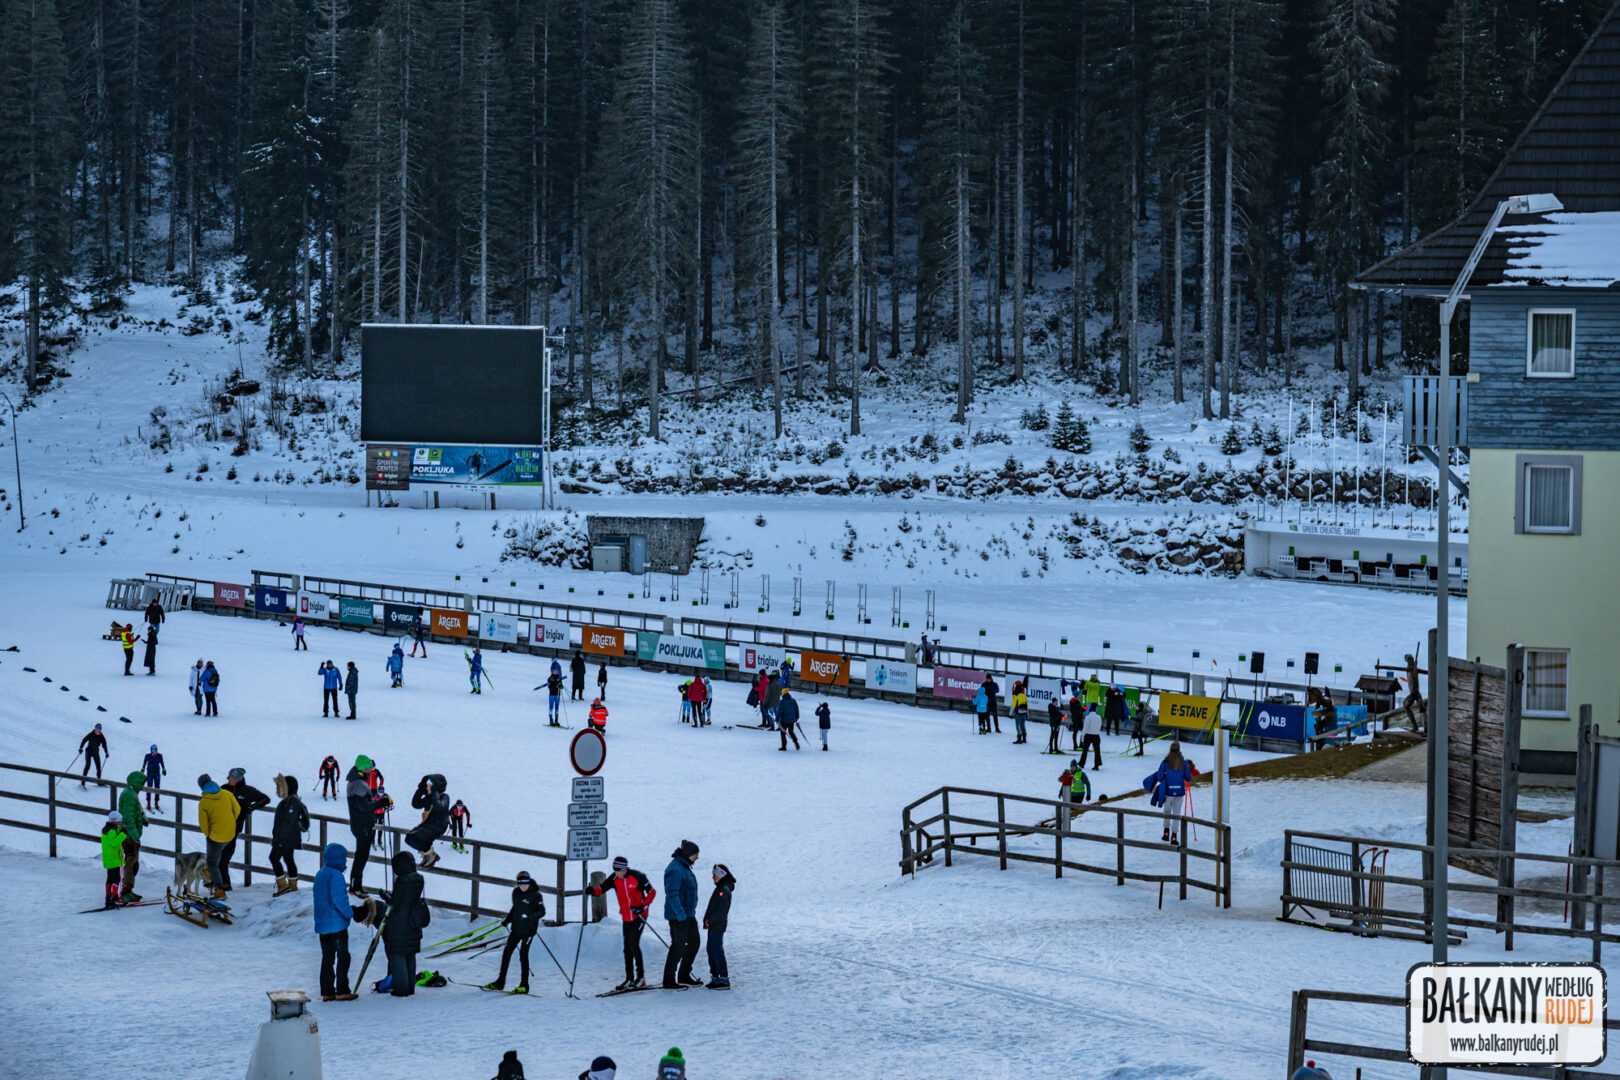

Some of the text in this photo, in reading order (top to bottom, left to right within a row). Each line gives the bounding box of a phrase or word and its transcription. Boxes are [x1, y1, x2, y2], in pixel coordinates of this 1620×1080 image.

[413, 466, 455, 474] POKLJUKA
[220, 587, 240, 602] ARGETA
[270, 596, 279, 605] NLB
[309, 600, 326, 614] triglav
[438, 614, 462, 630] ARGETA
[545, 628, 565, 643] triglav
[590, 632, 617, 649] ARGETA
[658, 643, 703, 660] POKLJUKA
[757, 654, 779, 670] triglav
[809, 658, 840, 677] ARGETA
[1271, 716, 1286, 727] NLB
